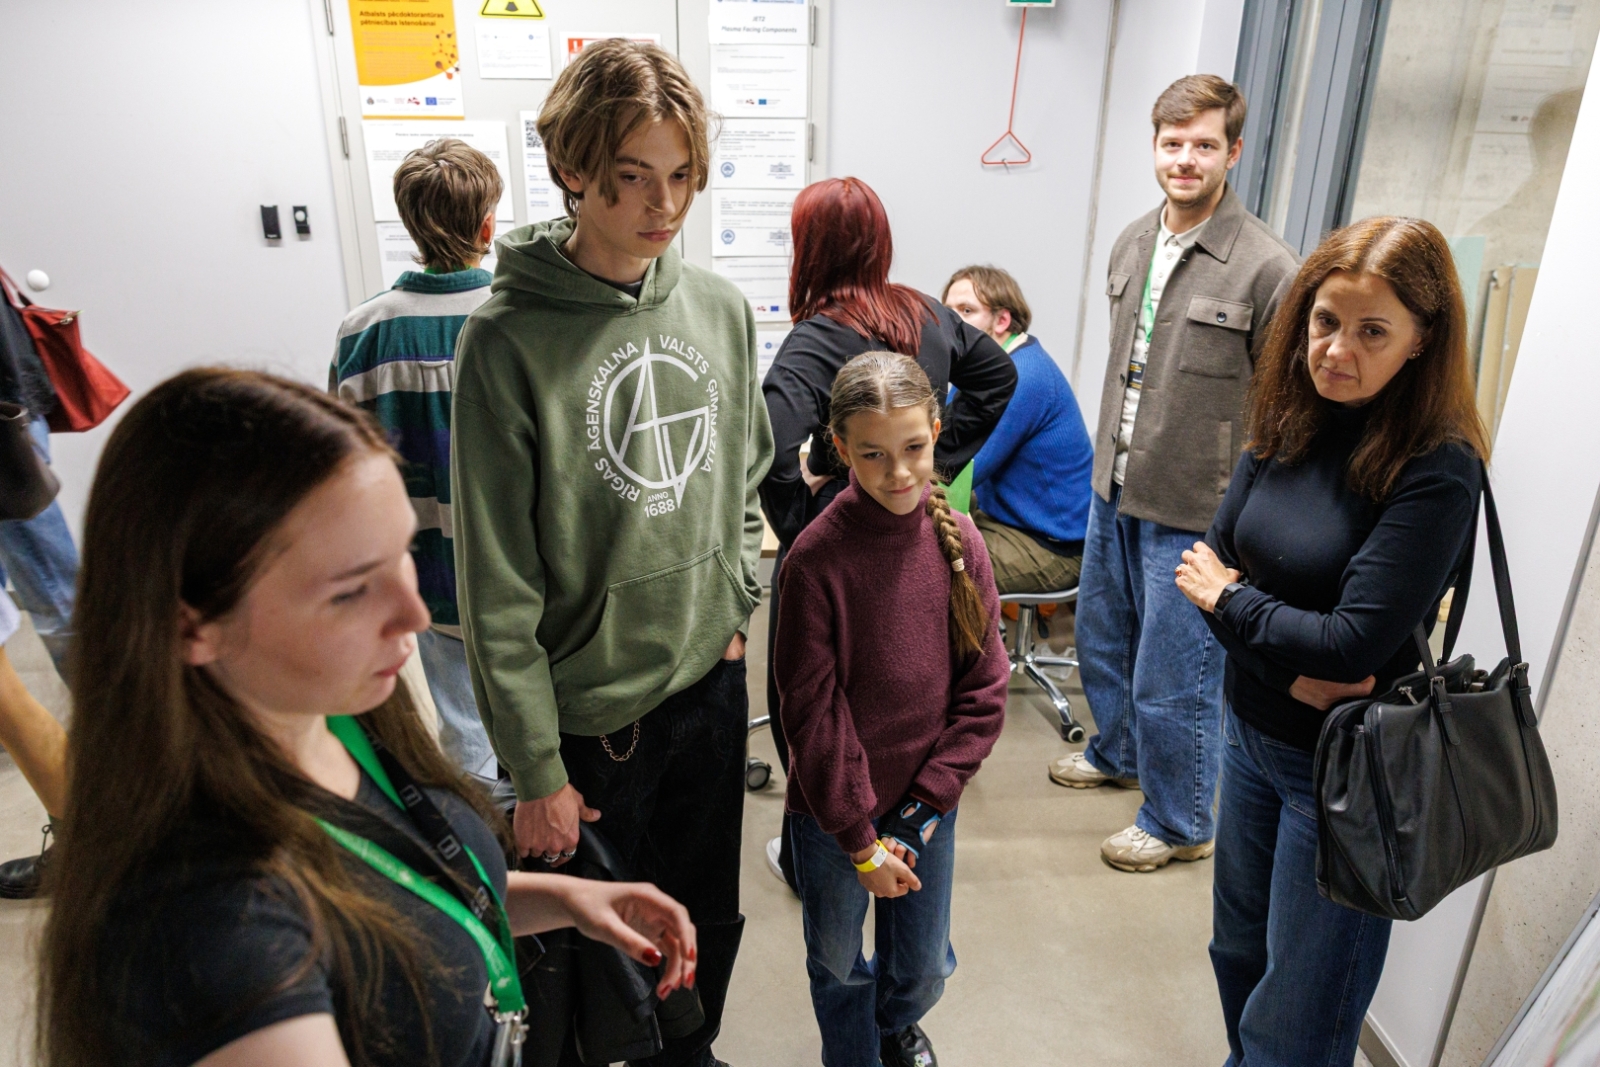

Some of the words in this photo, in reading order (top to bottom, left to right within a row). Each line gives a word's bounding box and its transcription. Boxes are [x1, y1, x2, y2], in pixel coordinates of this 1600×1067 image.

[659, 334, 709, 374] VALSTS
[587, 341, 639, 451] ĀGENSKALNA
[595, 457, 640, 502] RĪGAS
[647, 491, 669, 503] ANNO
[644, 498, 675, 518] 1688
